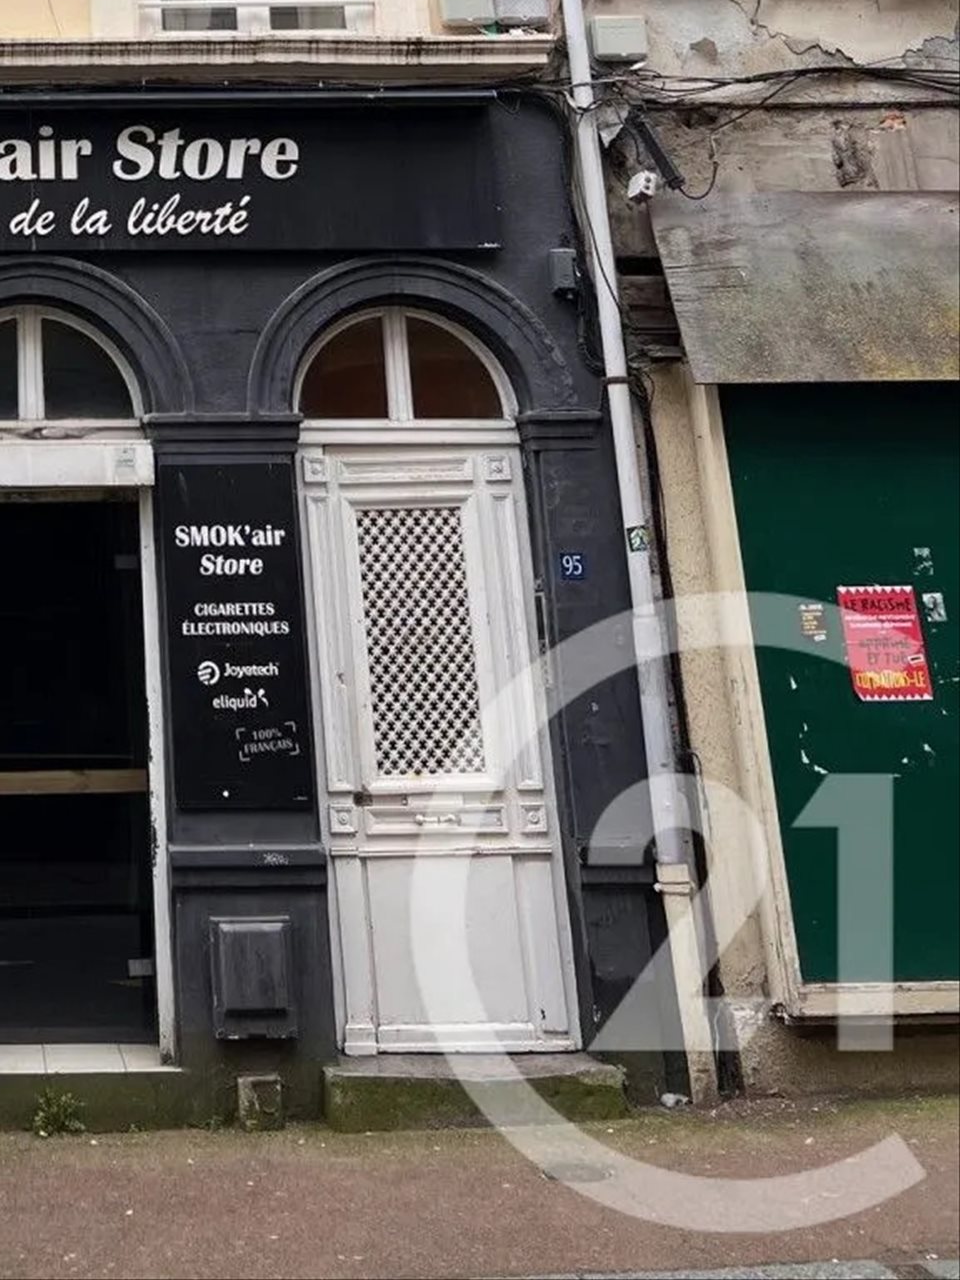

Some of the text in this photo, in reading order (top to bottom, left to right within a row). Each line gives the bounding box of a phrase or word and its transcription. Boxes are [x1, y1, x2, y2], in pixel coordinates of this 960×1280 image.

[112, 125, 300, 182] Store
[9, 196, 55, 237] de
[70, 196, 112, 236] la
[127, 194, 252, 236] liberté
[175, 524, 286, 548] SMOK'air
[199, 553, 264, 576] Store
[562, 555, 583, 576] 95
[194, 602, 276, 617] CIGARETTES
[182, 620, 290, 636] ÉLECTRONIQUES
[223, 663, 280, 679] Joyetech
[212, 689, 259, 711] eliquid
